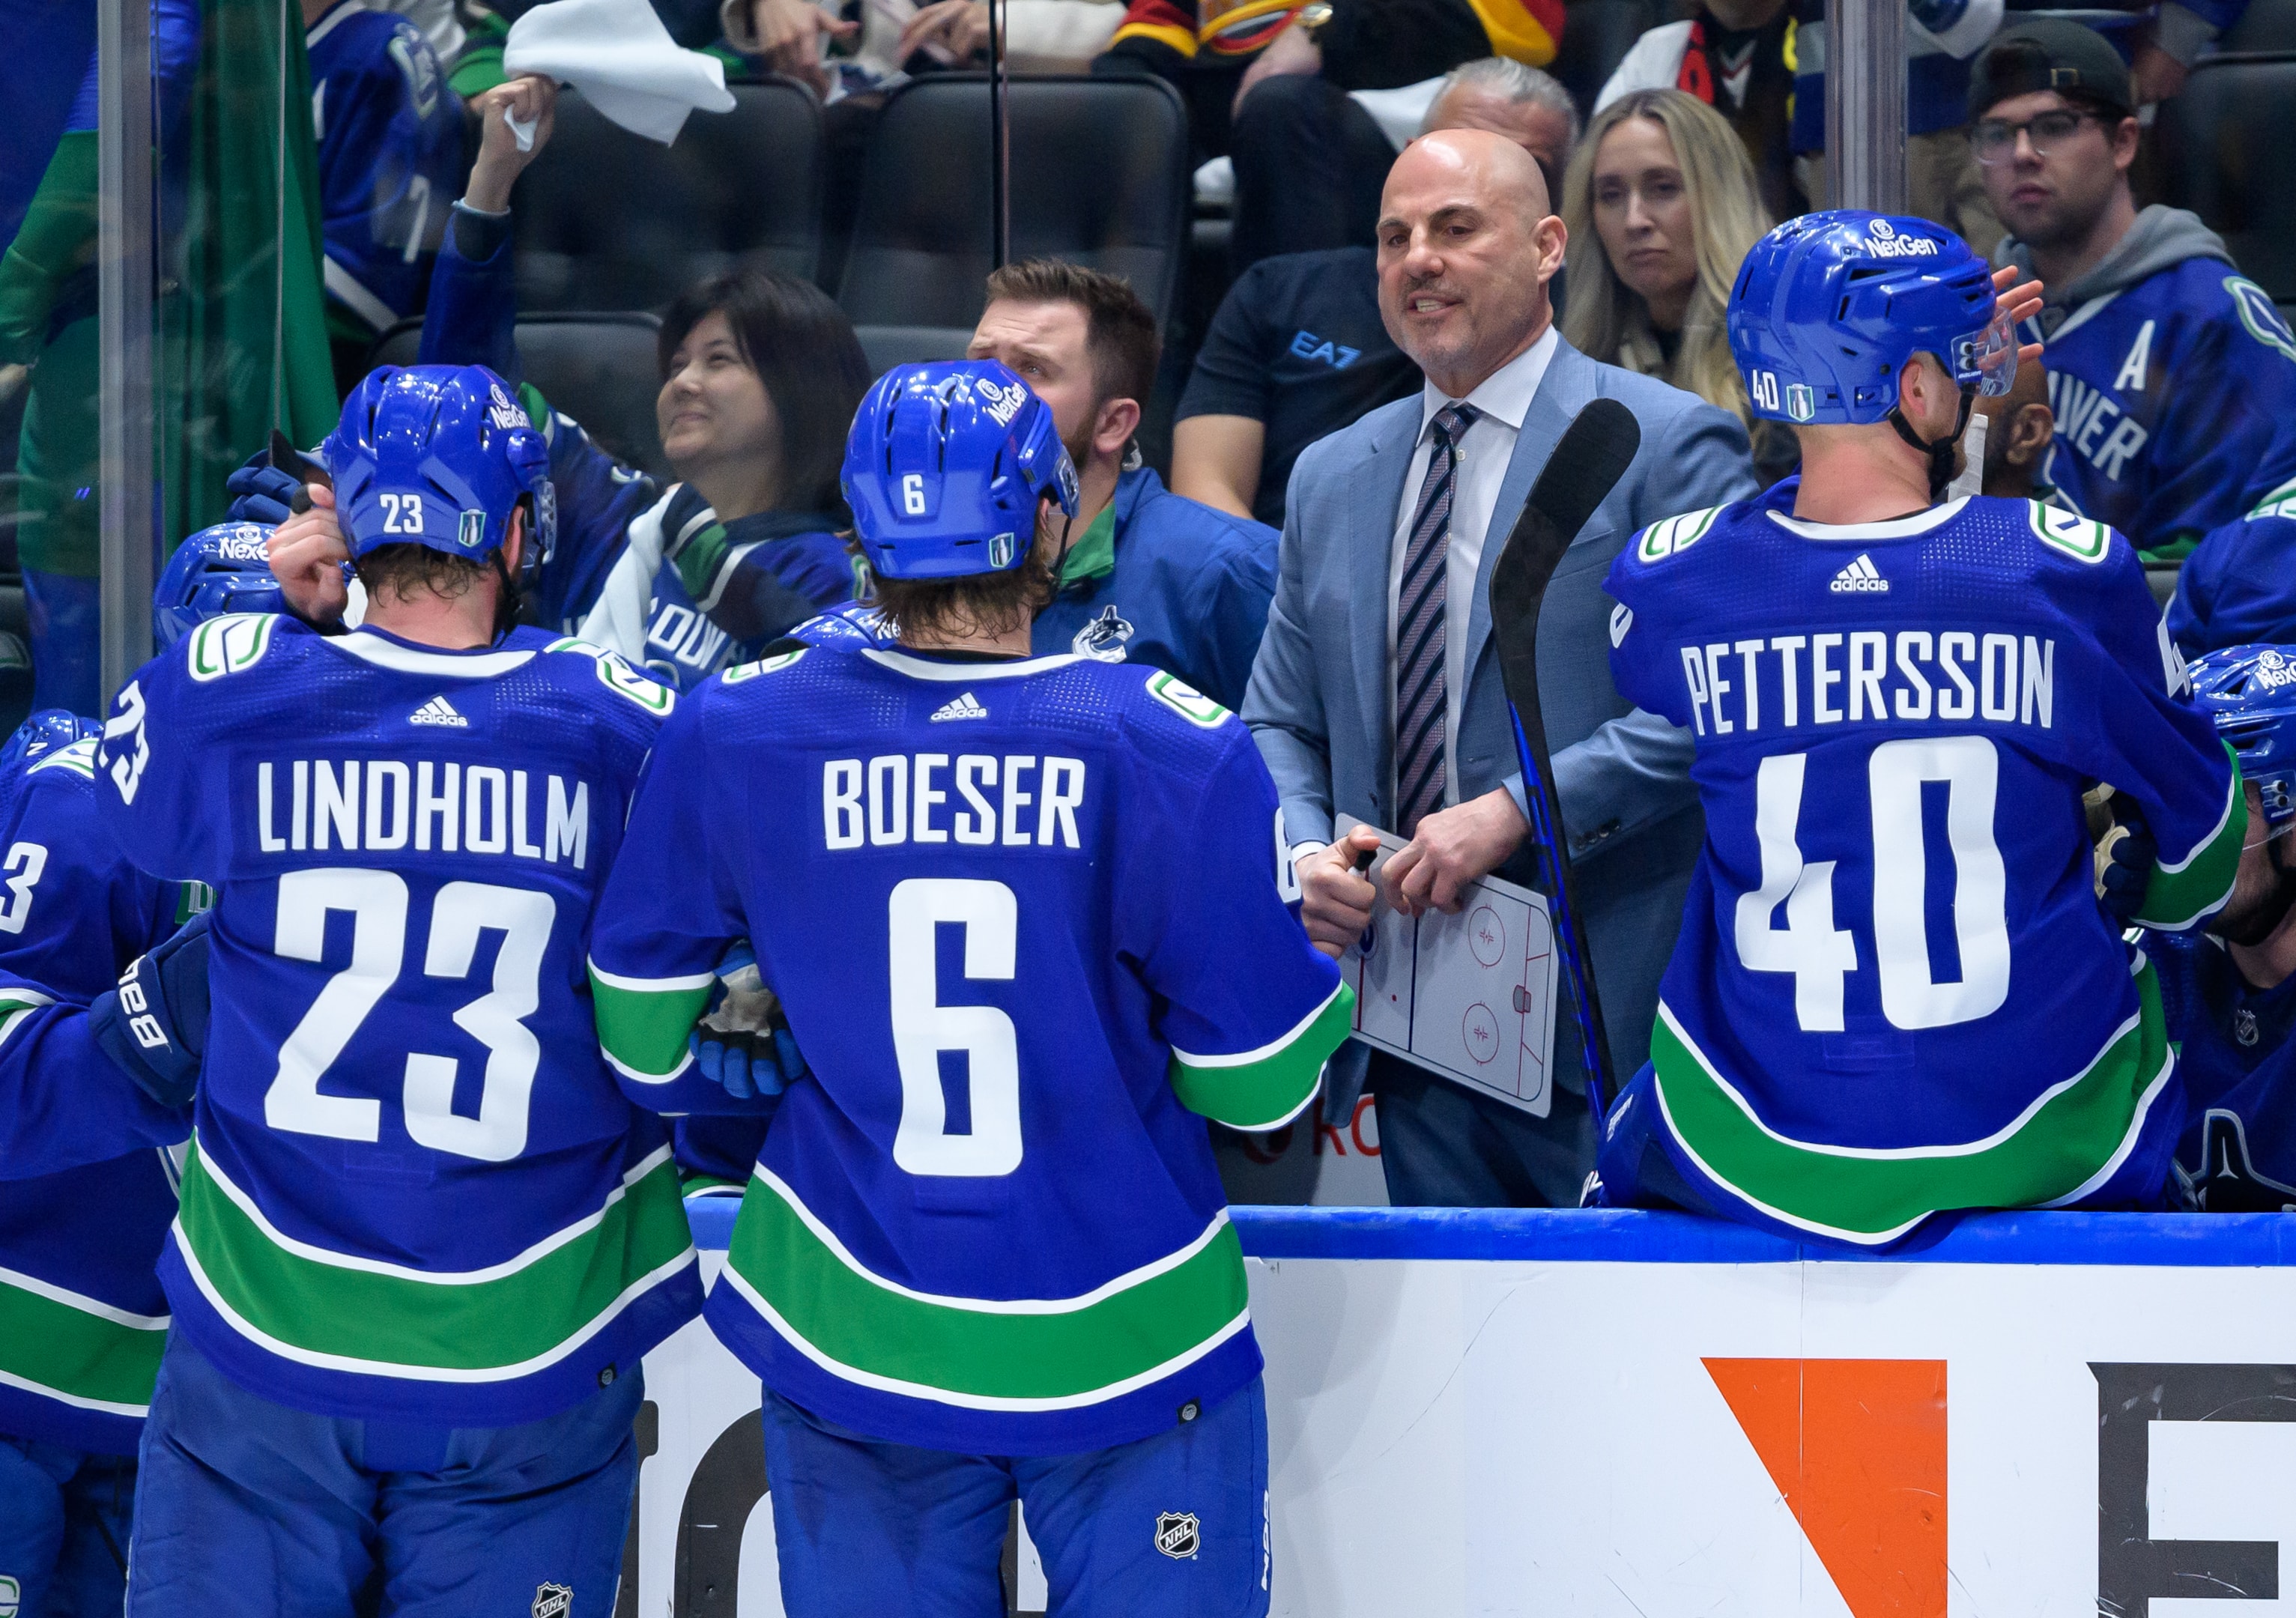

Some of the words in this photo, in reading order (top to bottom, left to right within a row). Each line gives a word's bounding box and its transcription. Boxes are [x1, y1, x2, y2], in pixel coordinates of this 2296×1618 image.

[1864, 232, 1939, 258] NexGen
[1289, 330, 1362, 372] EA7
[2112, 318, 2155, 391] A
[987, 381, 1029, 428] NexGen
[1751, 369, 1781, 411] 40
[379, 494, 424, 534] 23
[903, 474, 926, 515] 6
[1830, 574, 1889, 593] adidas
[1680, 631, 2055, 742] PETTERSSON
[409, 710, 468, 728] adidas
[930, 703, 987, 721] adidas
[258, 760, 589, 870] LINDHOLM
[823, 754, 1085, 850] BOESER
[1734, 734, 2011, 1031] 40
[264, 867, 556, 1162] 23
[888, 878, 1023, 1177] 6
[1164, 1523, 1193, 1548] NHL
[539, 1596, 566, 1617] NHL
